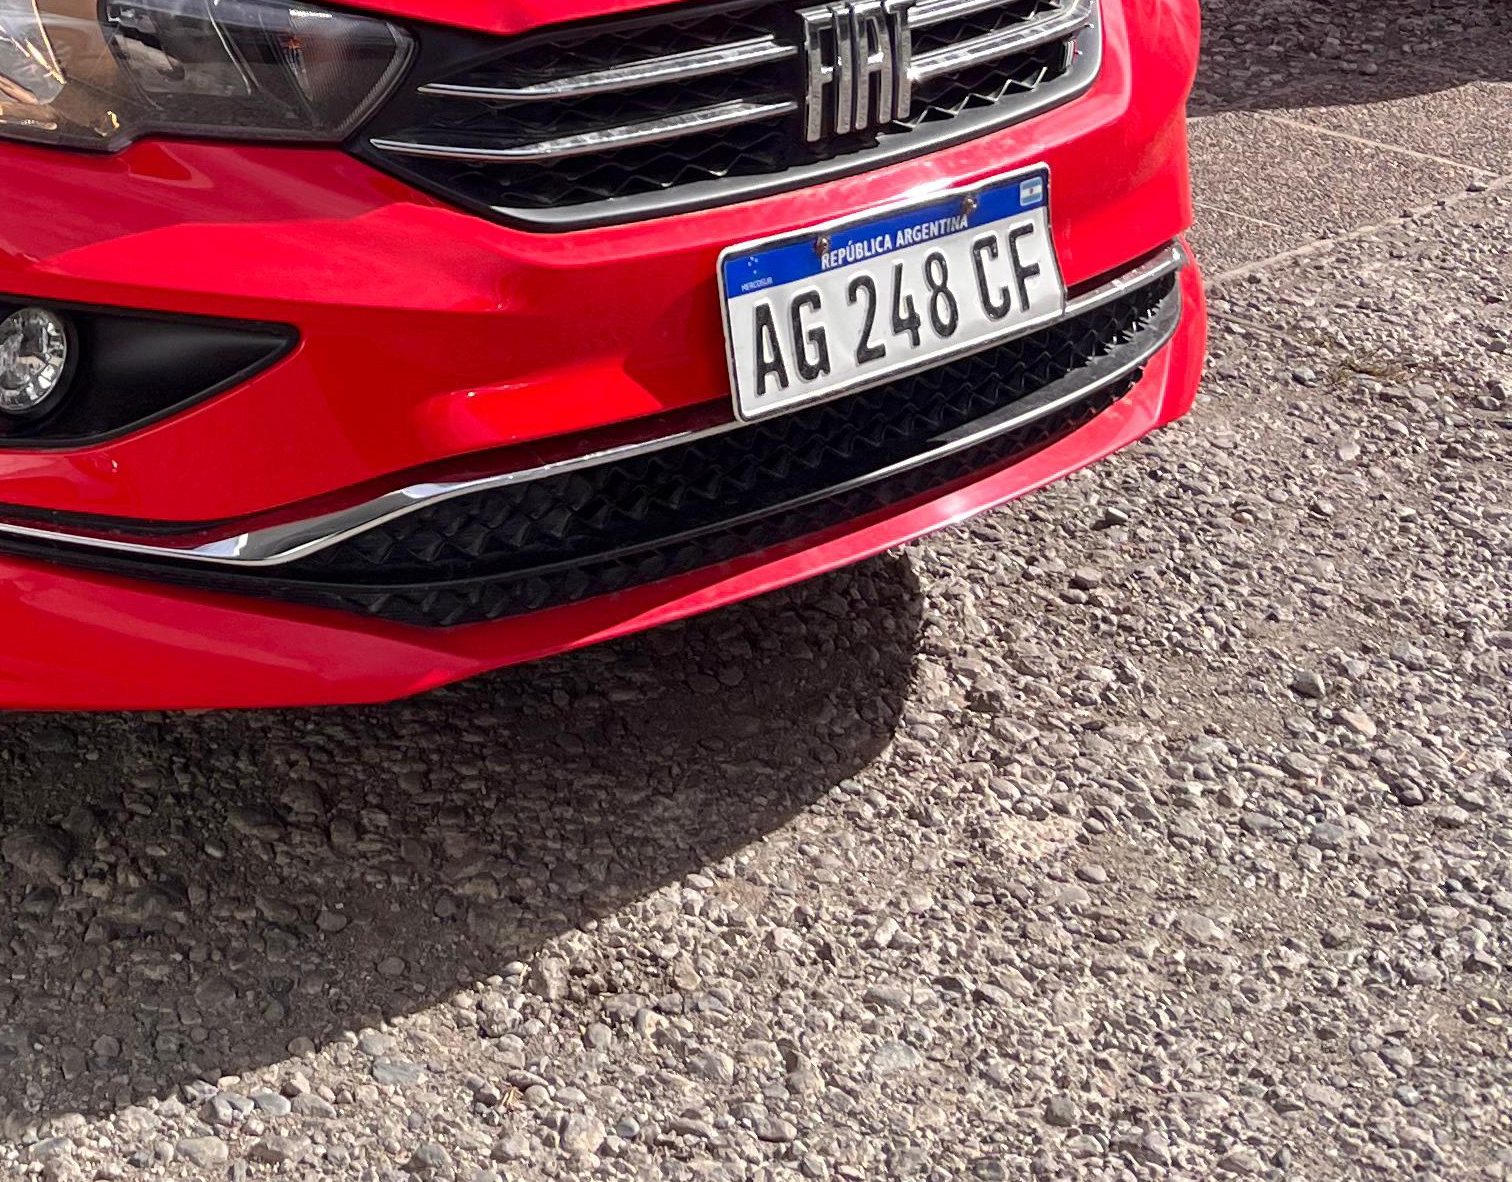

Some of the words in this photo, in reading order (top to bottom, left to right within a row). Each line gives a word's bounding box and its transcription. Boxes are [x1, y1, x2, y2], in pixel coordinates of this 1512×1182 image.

[821, 234, 893, 270] REPÚBLICA
[896, 214, 969, 247] ARGENTINA
[754, 289, 832, 397] AG
[846, 251, 960, 365] 248
[971, 222, 1041, 321] CF
